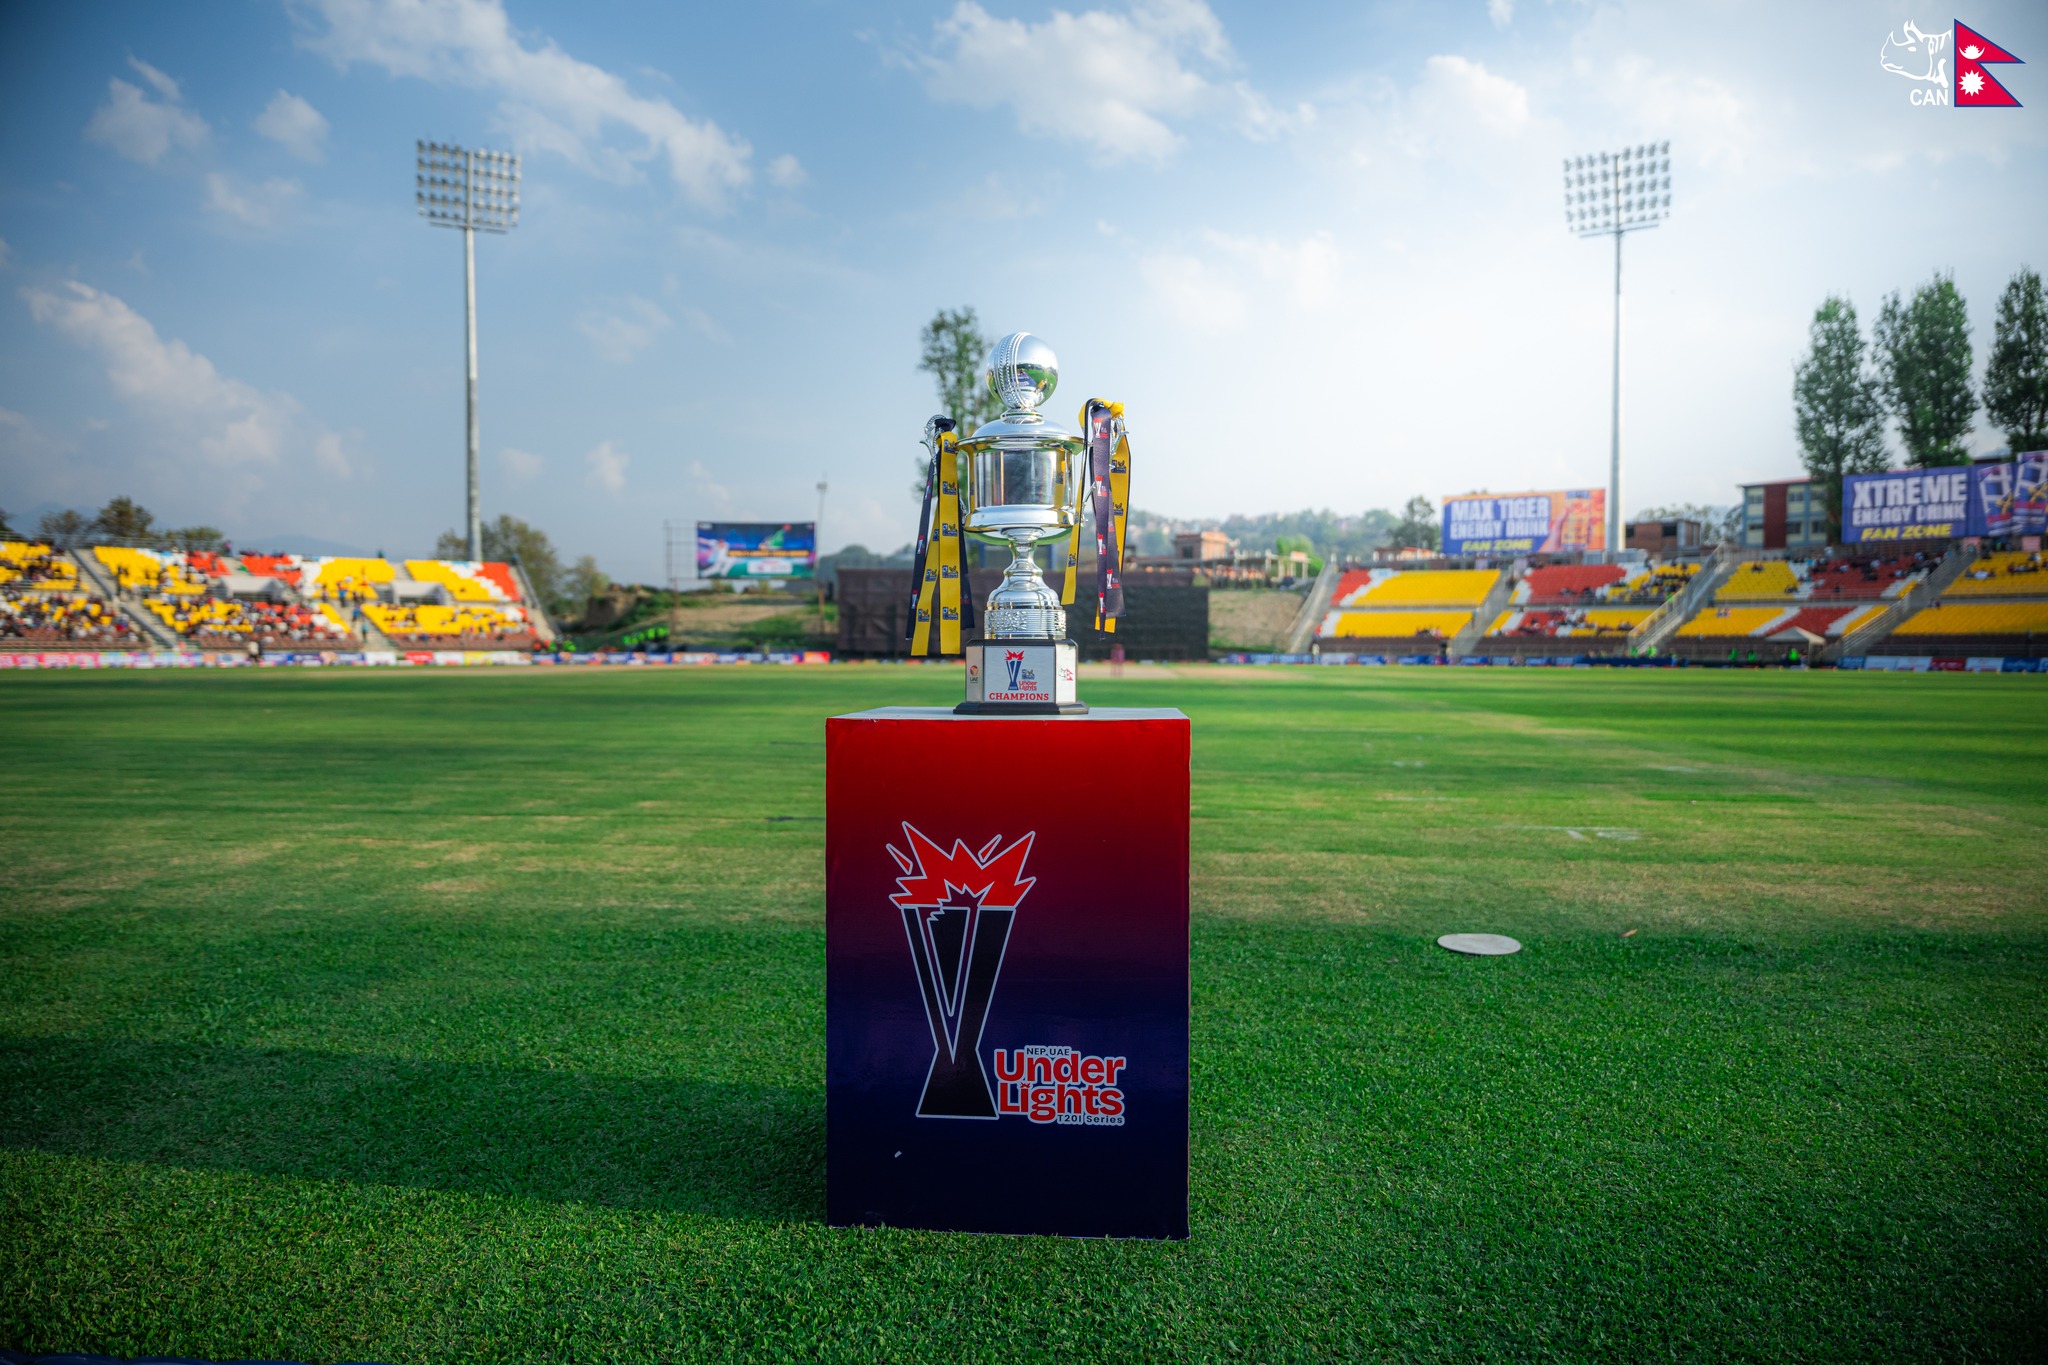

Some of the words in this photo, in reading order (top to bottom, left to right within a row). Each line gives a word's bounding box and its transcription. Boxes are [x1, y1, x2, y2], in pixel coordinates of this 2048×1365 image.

[1853, 473, 1968, 509] XTREME
[1451, 499, 1495, 521] MAX
[1498, 497, 1550, 519] TIGER
[1852, 503, 1912, 527] ENERGY
[1915, 501, 1967, 522] DRINK
[1451, 520, 1504, 540] ENERGY
[1505, 518, 1549, 538] DRINK
[1861, 526, 1899, 541] FAN
[1901, 523, 1953, 539] ZONE
[989, 692, 1049, 700] CHAMPIONS
[1050, 1048, 1070, 1056] UAE
[996, 1051, 1124, 1084] Under
[999, 1083, 1123, 1121] Lights
[1057, 1115, 1082, 1123] T20I
[1086, 1115, 1123, 1124] Series
